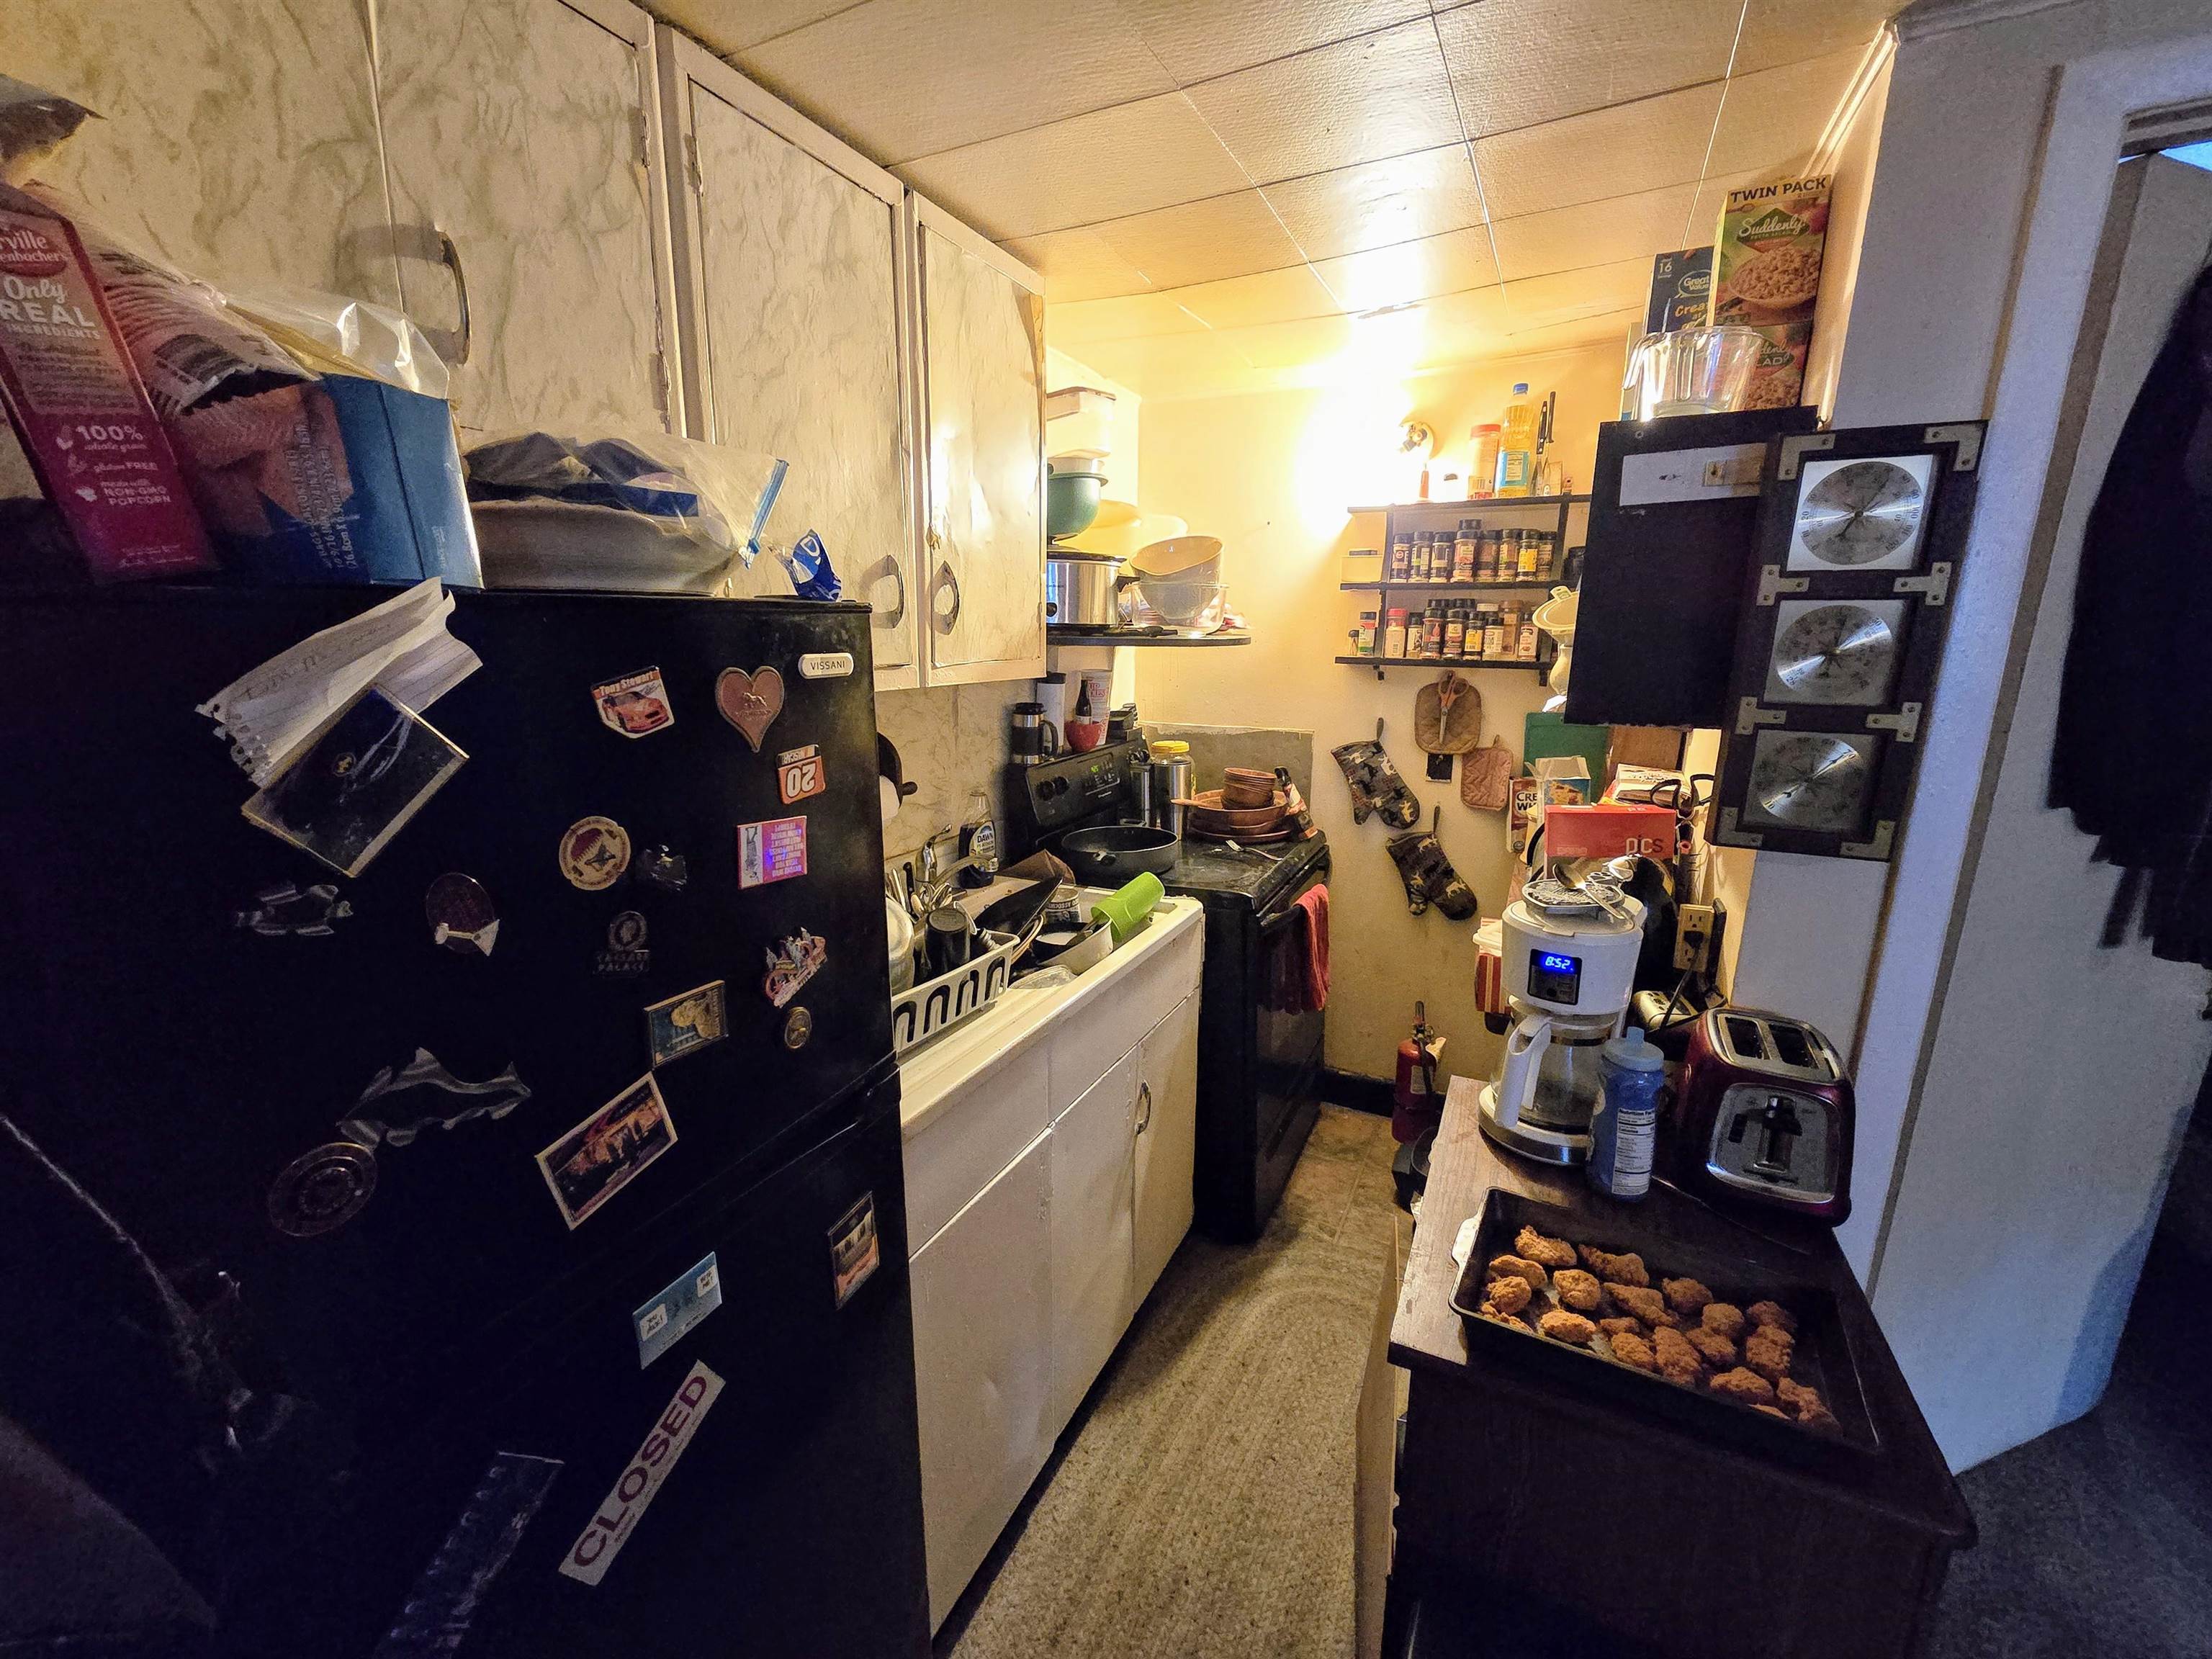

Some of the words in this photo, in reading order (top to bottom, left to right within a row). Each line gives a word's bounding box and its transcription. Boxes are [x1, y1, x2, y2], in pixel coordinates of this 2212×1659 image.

[1731, 185, 1778, 203] TWIN
[1782, 177, 1827, 194] PACK
[1658, 262, 1673, 273] 16
[1683, 275, 1709, 287] Great
[3, 276, 67, 304] Only
[0, 300, 96, 328] REAL
[76, 425, 144, 441] 100%
[125, 462, 159, 472] FREE
[104, 485, 167, 496] NON-GMO
[109, 495, 172, 506] POPCORN
[1802, 511, 1809, 520] 20
[1911, 506, 1920, 519] 100
[809, 660, 846, 670] VISSANI
[621, 670, 655, 689] Stewart
[786, 763, 817, 798] 20
[1516, 791, 1537, 801] CRE
[977, 832, 994, 843] DAWN
[1545, 956, 1571, 970] 8:52
[574, 1375, 709, 1568] CLOSED
